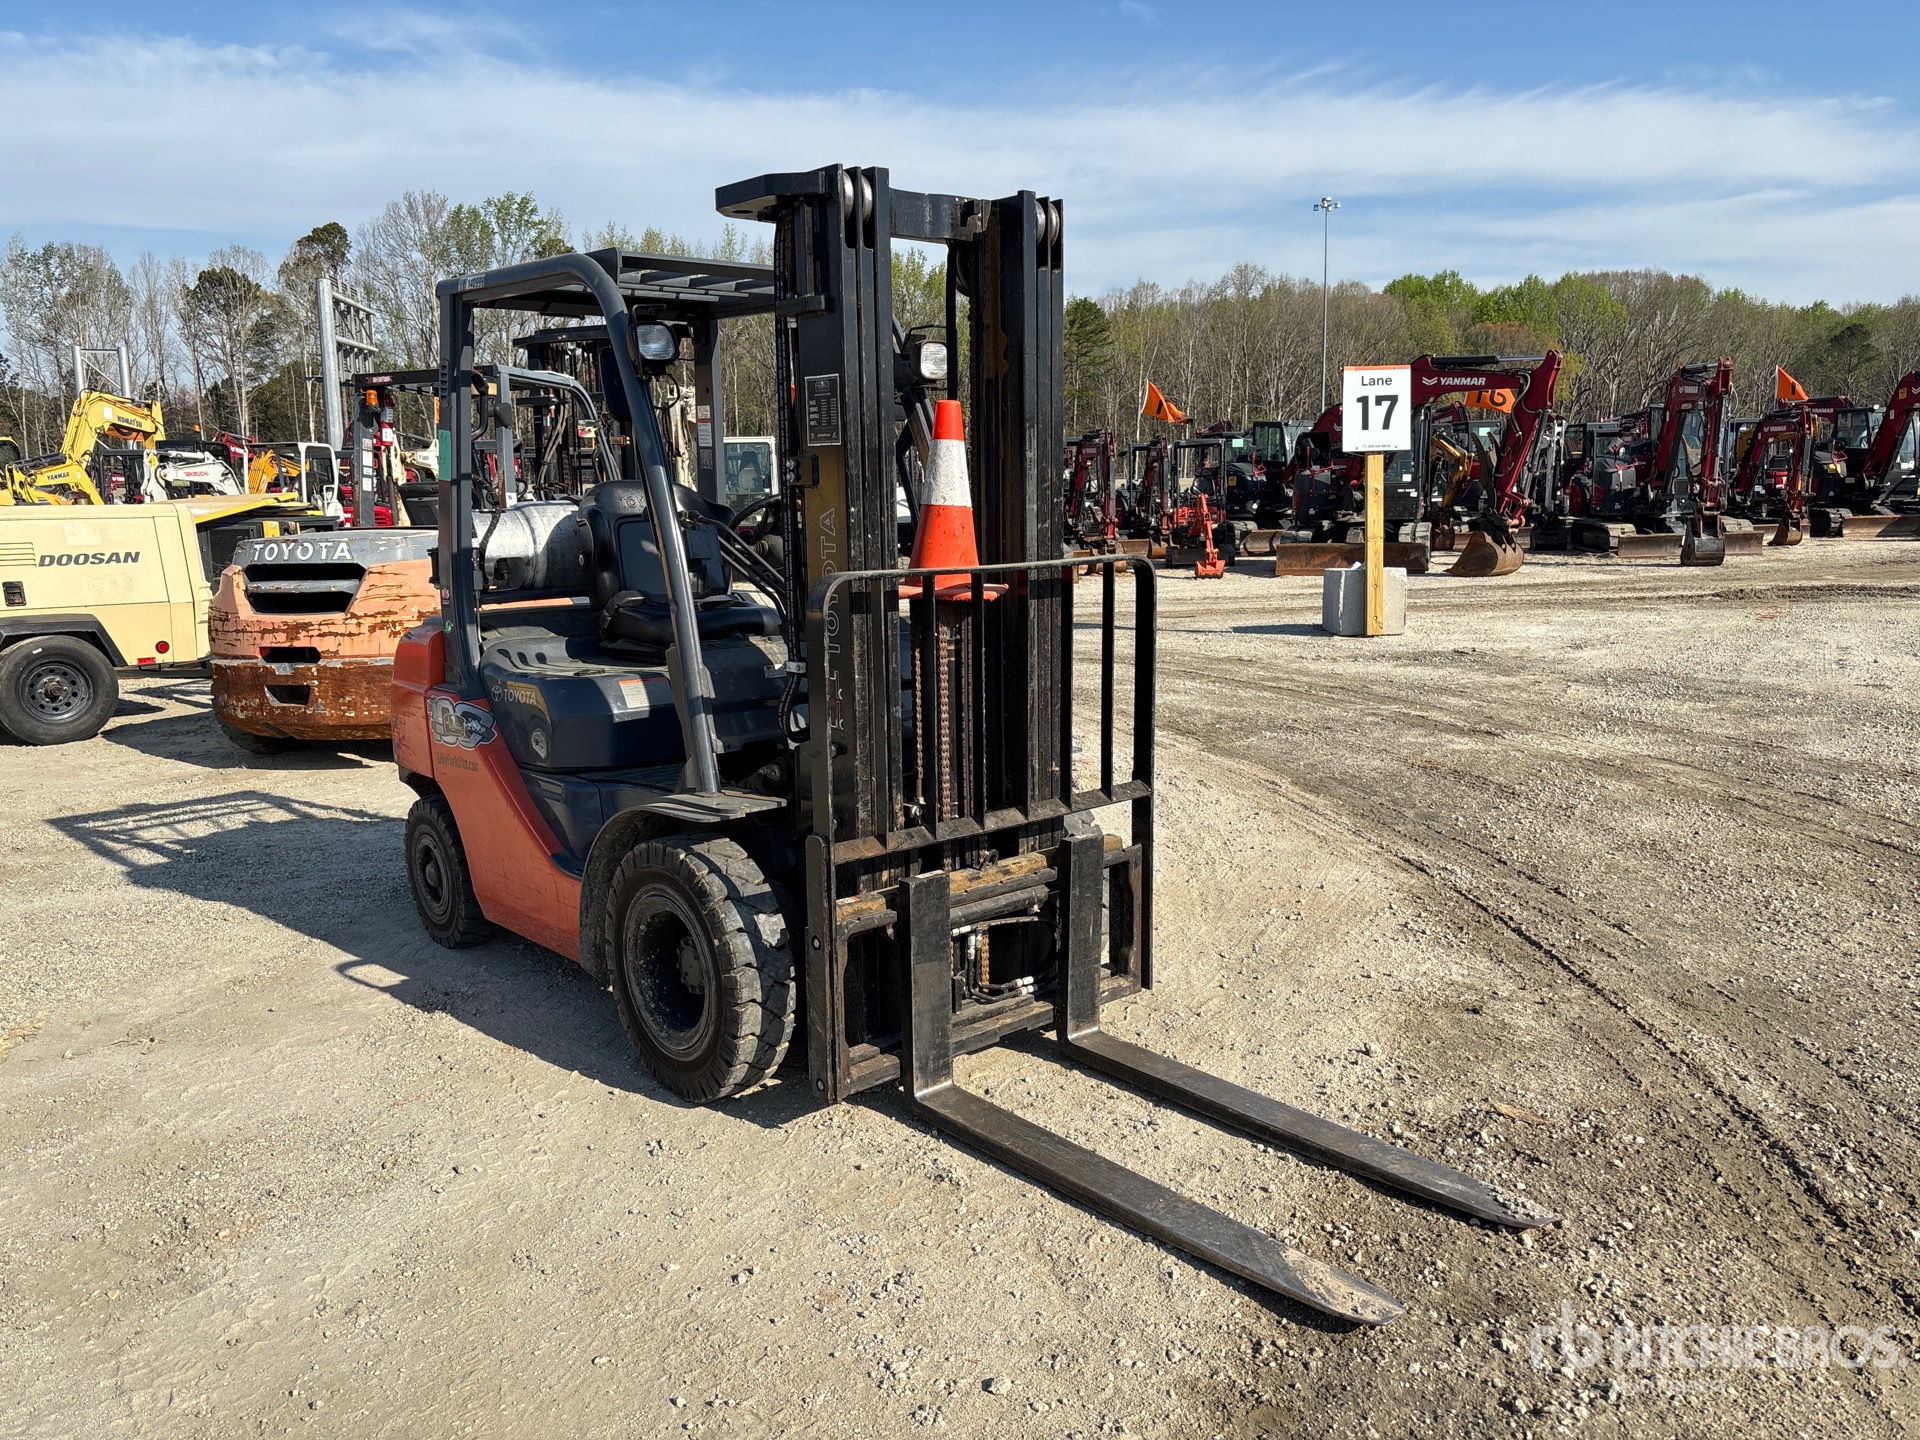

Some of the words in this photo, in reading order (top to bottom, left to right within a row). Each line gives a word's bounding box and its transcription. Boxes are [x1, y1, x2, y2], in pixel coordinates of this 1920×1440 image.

[1361, 375, 1393, 387] Lane
[1440, 377, 1486, 386] YANMAR
[1356, 394, 1399, 431] 17
[117, 415, 143, 428] KOMATSU
[47, 471, 70, 481] YANMAR
[253, 541, 352, 561] TOYOTA
[38, 551, 141, 568] DOOSAN
[503, 688, 537, 705] TOYOTA
